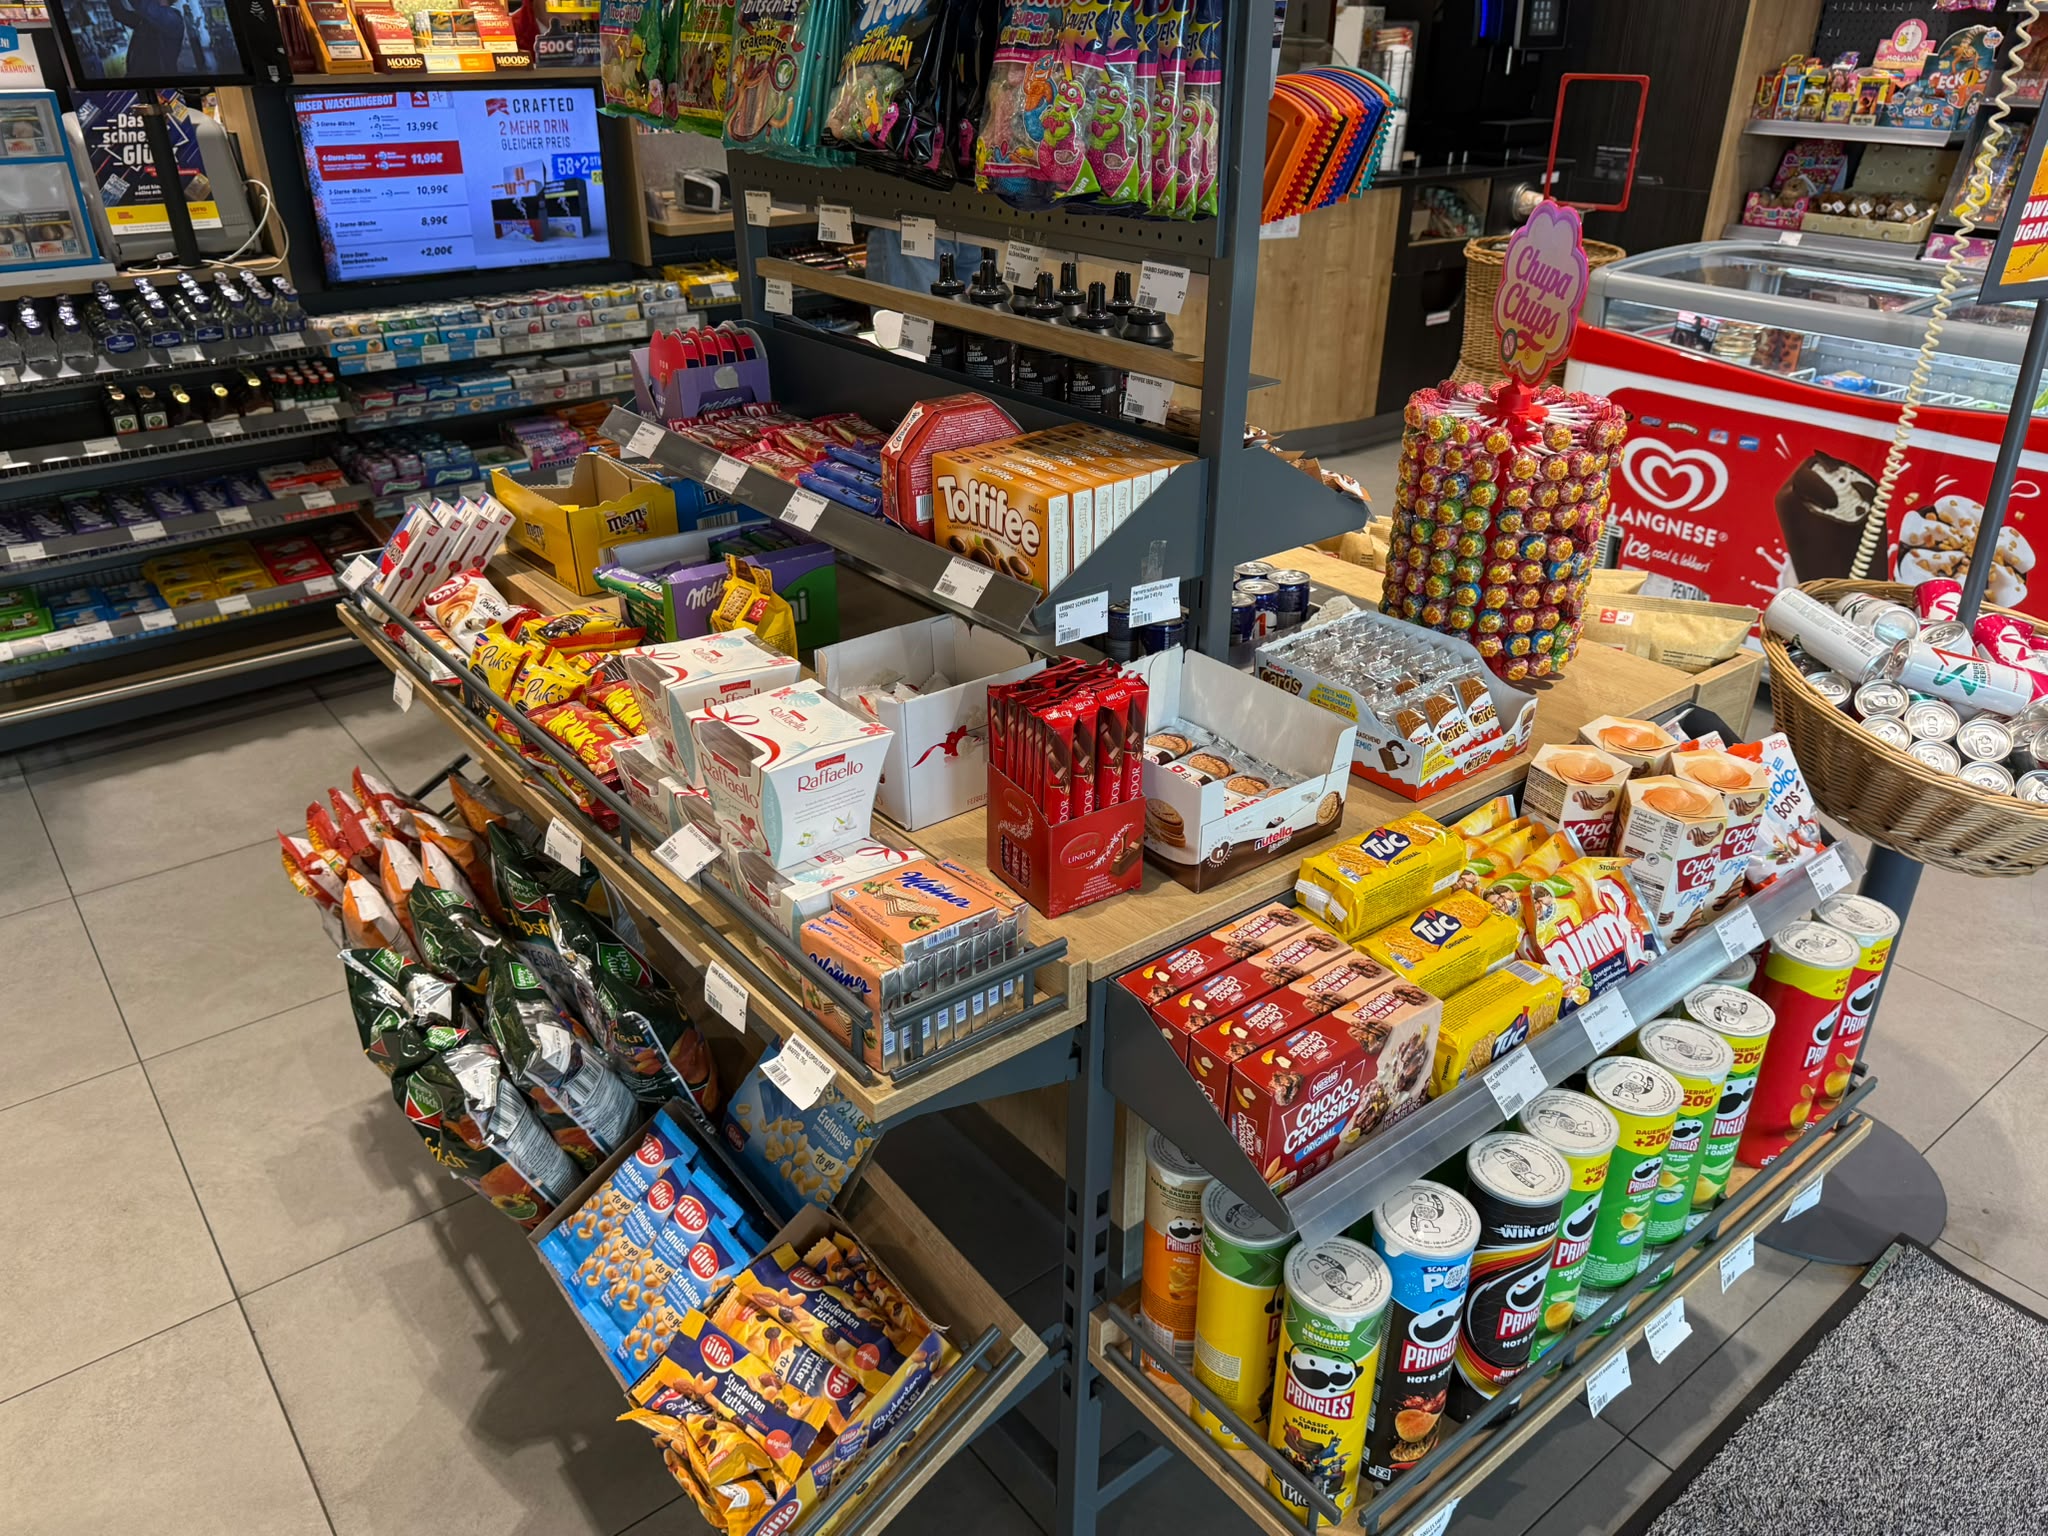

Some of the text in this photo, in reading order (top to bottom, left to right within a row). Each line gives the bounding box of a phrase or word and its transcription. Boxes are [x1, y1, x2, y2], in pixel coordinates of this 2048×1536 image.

[538, 39, 574, 52] 500€
[740, 32, 788, 53] Krakenarme
[387, 57, 423, 68] MOODS
[496, 55, 530, 66] MOODS
[294, 94, 394, 113] UNSER WASCHANGEBOT
[513, 97, 574, 114] CRAFTED
[118, 113, 145, 128] Das
[406, 121, 439, 132] 13,99€
[499, 118, 569, 136] 2 MEHR DRIN
[501, 135, 571, 151] GLEICHER PREIS
[411, 152, 443, 165] 11,99€
[417, 184, 449, 196] 10,99€
[421, 215, 448, 226] 8,99€
[420, 245, 453, 256] +2,00€
[1515, 246, 1573, 300] Chupa
[1503, 283, 1561, 340] Chups
[701, 396, 743, 413] Milka
[540, 457, 577, 469] mento
[936, 475, 1041, 557] Toffifee
[1651, 549, 1671, 562] cool
[685, 579, 724, 610] Milk
[480, 644, 512, 672] Puk's
[525, 677, 564, 704] Puk's
[1260, 669, 1299, 695] Cards
[1105, 689, 1126, 702] MILCH
[769, 706, 806, 733] Raffaello
[1470, 704, 1497, 728] Cards
[1440, 720, 1468, 745] Cards
[1768, 738, 1788, 752] 125g
[700, 752, 759, 809] Raffaello
[797, 760, 864, 793] Raffaello
[1775, 788, 1802, 818] Bons
[1254, 826, 1293, 852] nutella
[1363, 831, 1410, 859] TUC
[1067, 848, 1097, 864] LINDOR
[1393, 849, 1422, 866] ORIGINAL
[895, 870, 971, 910] Manner
[1231, 916, 1270, 941] HAMBURG
[1412, 914, 1459, 942] TUC
[1445, 933, 1473, 950] ORIGINAL
[1168, 949, 1200, 973] CROSSIES
[1178, 956, 1205, 975] CHOCO
[1268, 941, 1308, 967] HAMBURG
[1204, 975, 1238, 1001] CROSSIES
[1311, 966, 1350, 993] HAMBURG
[1215, 982, 1243, 1002] CHOCO
[1245, 1002, 1280, 1029] CROSSIES
[1352, 992, 1396, 1022] HAMBURG
[1256, 1010, 1286, 1030] CHOCO
[791, 1037, 807, 1053] MANNER
[1288, 1030, 1323, 1058] CROSSIES
[1299, 1039, 1329, 1060] CHOCO
[1492, 1024, 1528, 1060] TUC
[1311, 1071, 1340, 1095] Nestlé
[1296, 1077, 1353, 1123] CHOCO
[816, 1107, 853, 1150] Erdnüsse
[1284, 1087, 1361, 1154] CROSSIES
[1302, 1124, 1338, 1157] ORIGINAL
[814, 1150, 836, 1173] to go
[611, 1193, 631, 1211] to go
[650, 1181, 673, 1209] ültje
[632, 1201, 658, 1239] Erdnüsse
[677, 1197, 708, 1229] ültje
[1500, 1225, 1536, 1239] WIN
[620, 1240, 639, 1258] to go
[691, 1245, 718, 1277] ültje
[655, 1262, 667, 1276] to
[792, 1268, 823, 1290] ültje
[1427, 1265, 1449, 1275] SCAN
[672, 1267, 702, 1308] Erdnüsse
[812, 1303, 841, 1330] Futter
[814, 1292, 861, 1329] Studenten
[1301, 1329, 1351, 1348] REWARDS
[1503, 1338, 1521, 1349] HOT
[703, 1337, 732, 1367] ültje
[857, 1349, 879, 1365] original
[1406, 1373, 1426, 1384] HOT
[720, 1391, 750, 1417] Futter
[723, 1373, 767, 1414] Studenten
[871, 1373, 922, 1432] Studenten
[1286, 1378, 1352, 1418] PRINGLES
[1292, 1417, 1335, 1436] PAPRIKA
[1298, 1415, 1329, 1429] CLASSIC
[766, 1436, 792, 1452] original
